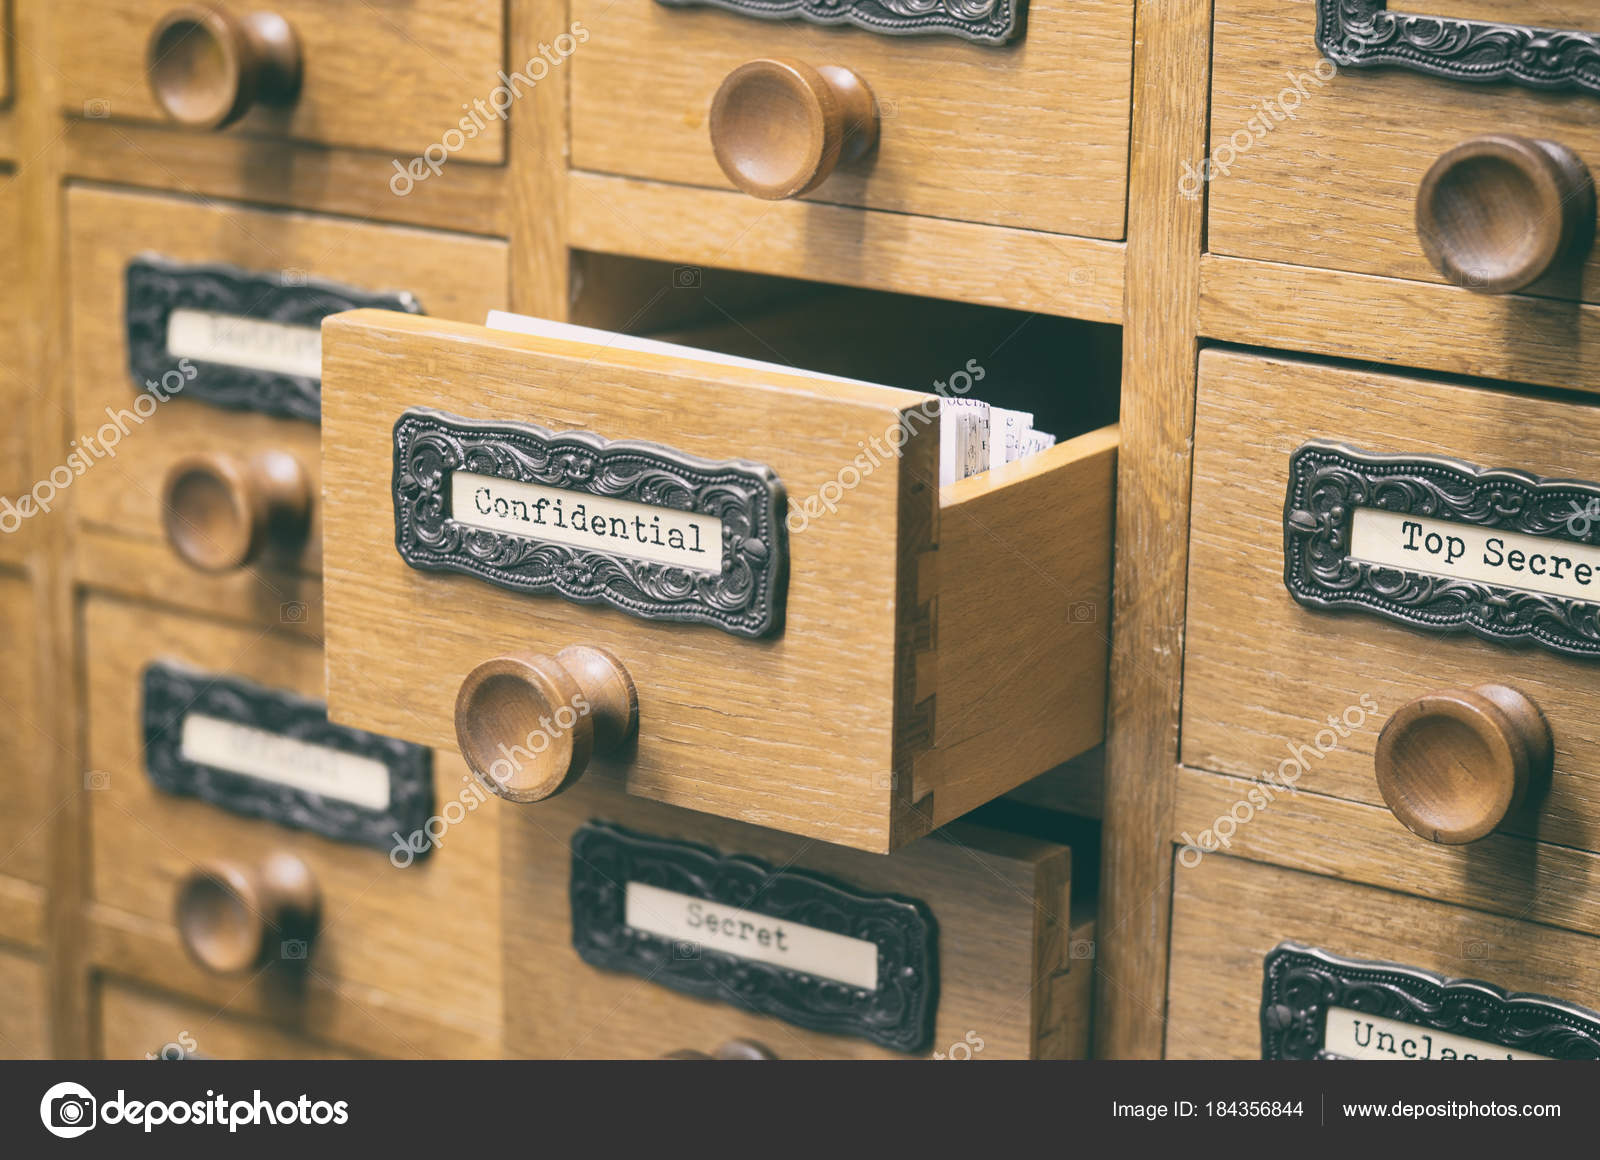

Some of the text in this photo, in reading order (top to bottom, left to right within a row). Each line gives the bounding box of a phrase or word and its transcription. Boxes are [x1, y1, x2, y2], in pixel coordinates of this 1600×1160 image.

[474, 487, 706, 552] Confidential
[1402, 521, 1600, 585] Top Secre
[685, 903, 789, 951] Secret
